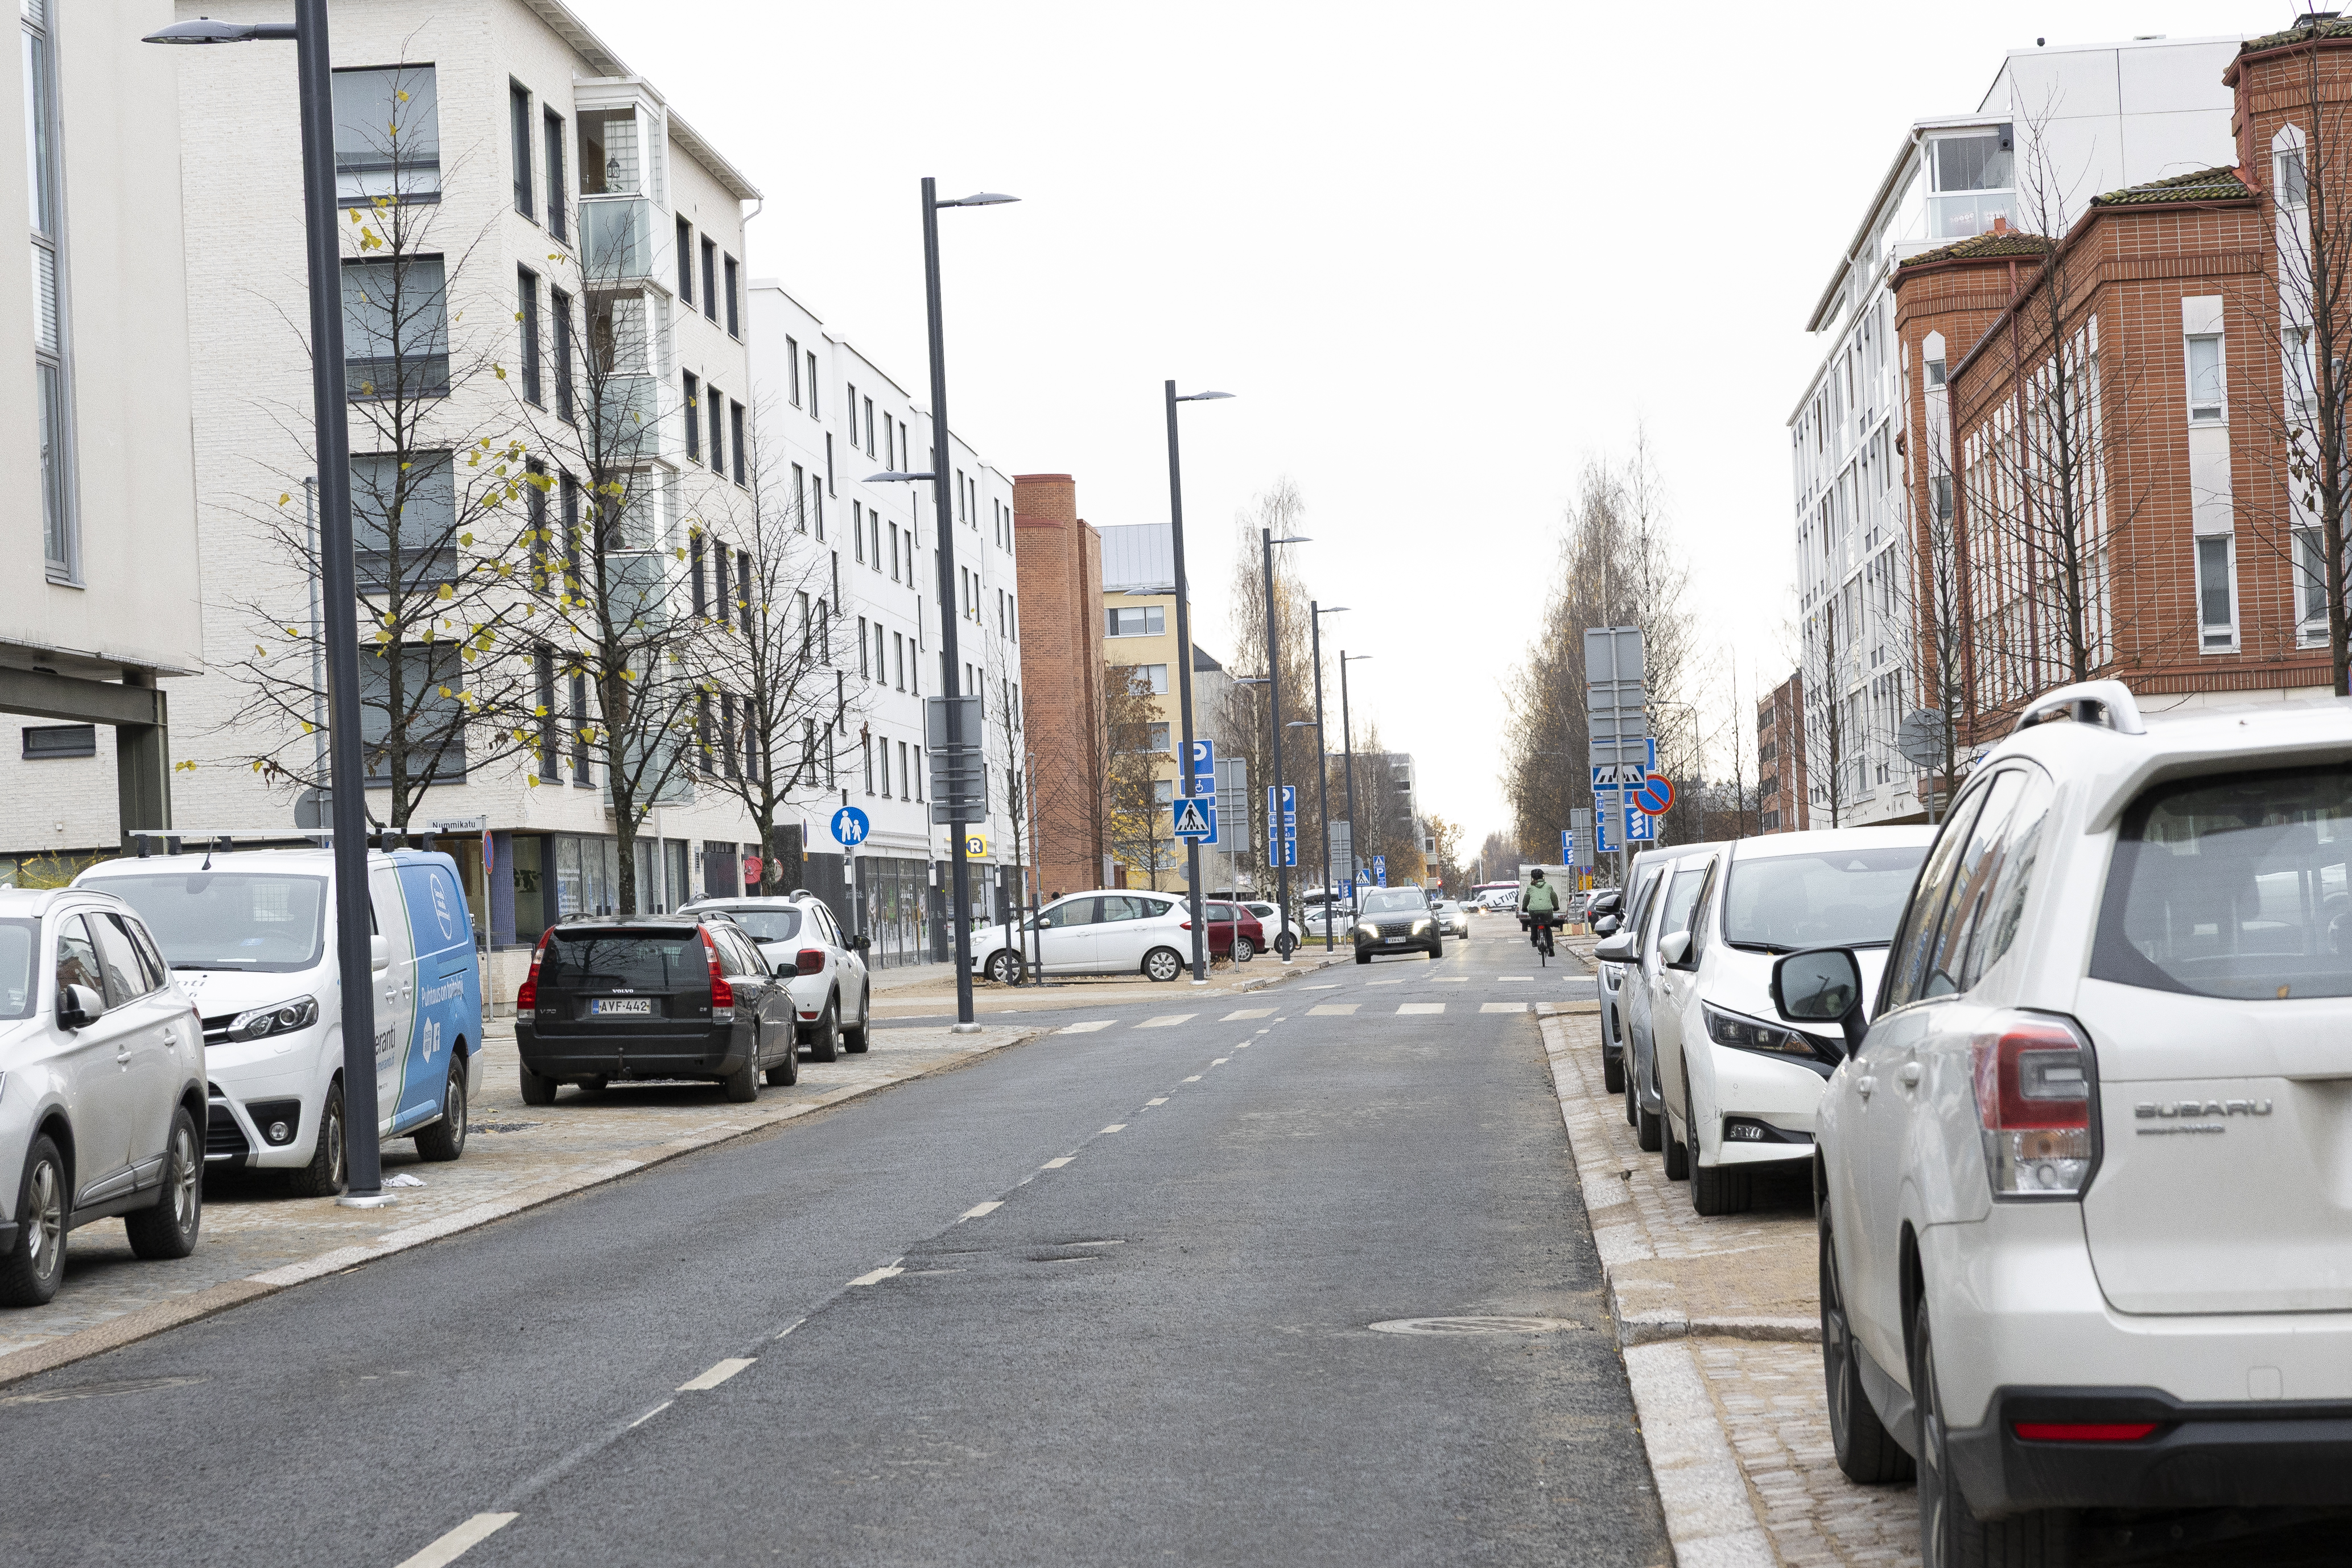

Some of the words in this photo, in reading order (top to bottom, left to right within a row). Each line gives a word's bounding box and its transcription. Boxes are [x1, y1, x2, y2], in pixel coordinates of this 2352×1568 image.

[432, 820, 476, 829] Nummikatu
[969, 839, 981, 853] R
[1377, 868, 1384, 878] P
[422, 984, 441, 1008] Puhtaus
[441, 985, 448, 1001] on
[601, 1001, 648, 1012] AVF-442
[375, 1022, 395, 1055] eranti
[2135, 1099, 2273, 1119] SUBARU
